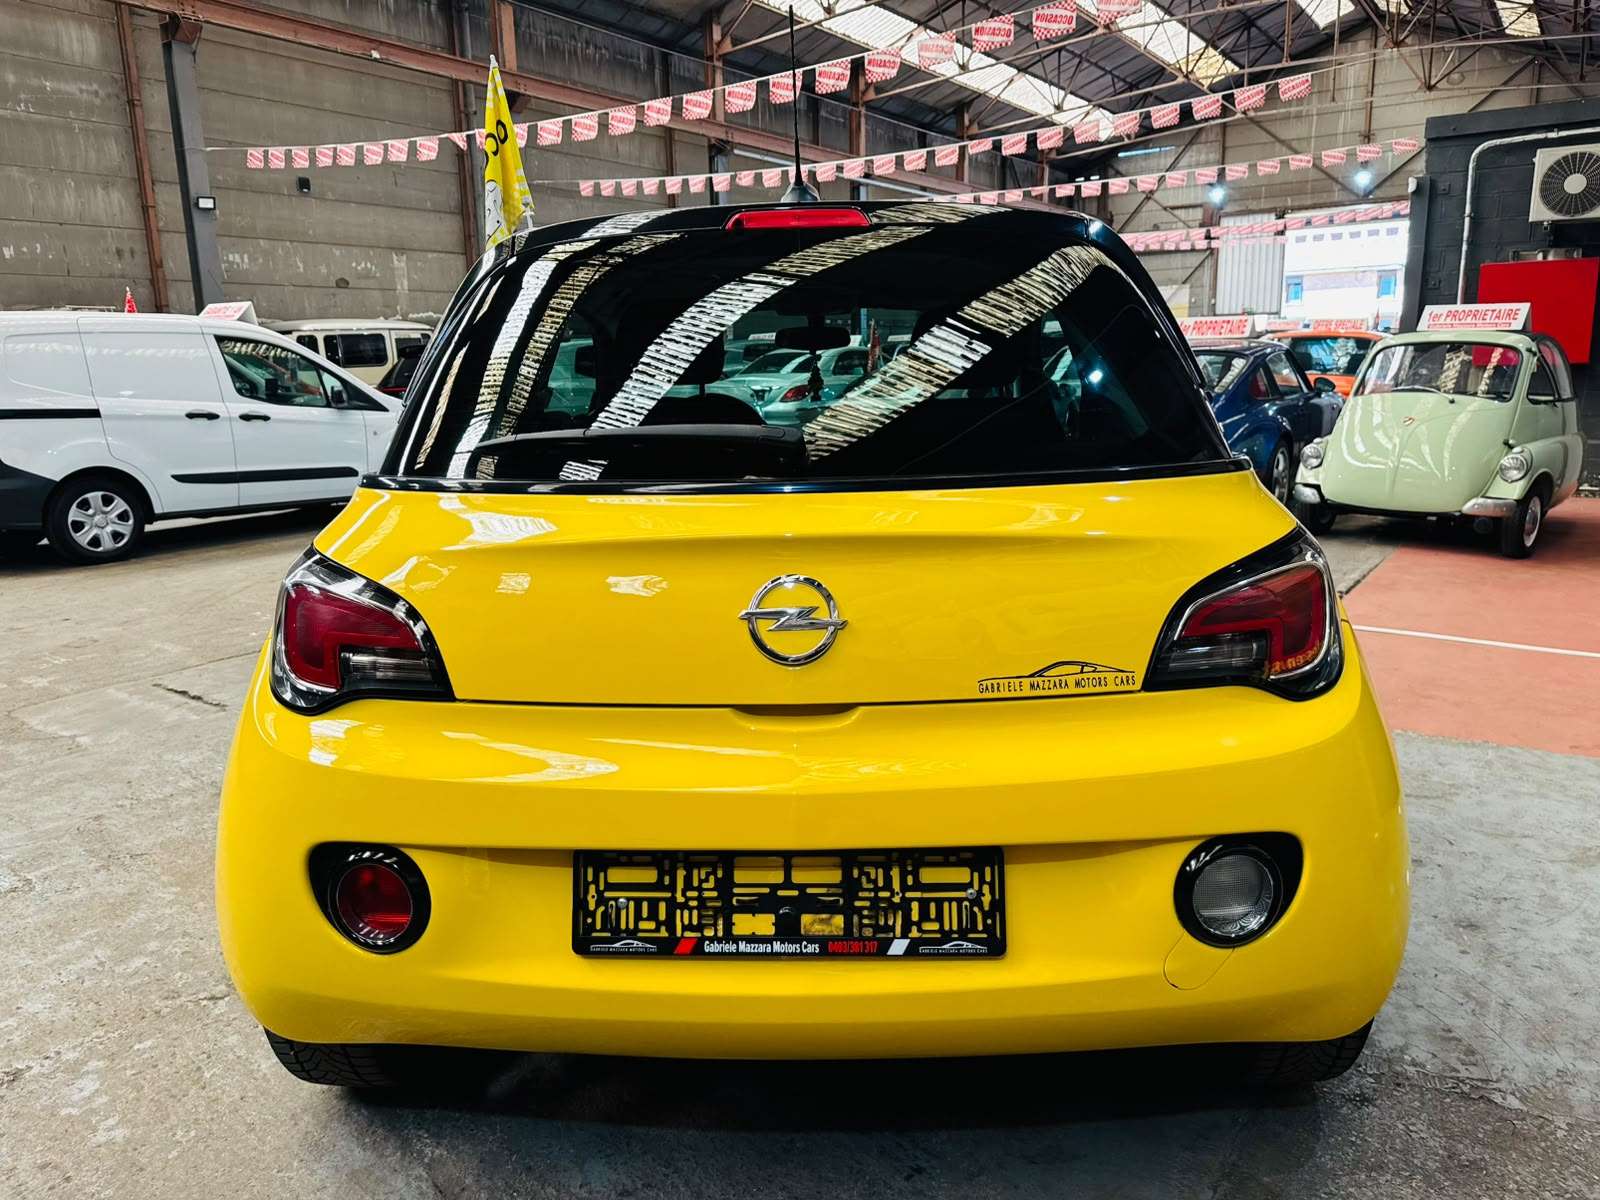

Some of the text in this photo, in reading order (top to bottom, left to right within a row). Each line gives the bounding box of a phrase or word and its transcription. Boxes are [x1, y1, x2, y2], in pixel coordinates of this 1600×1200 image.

[1428, 308, 1521, 322] 1er PROPRIETAIRE
[1192, 319, 1248, 336] PROPRIETAIRE
[978, 675, 1136, 694] GABRIELE MAZZARA MOTORS CARS
[704, 941, 737, 953] Gabriele
[738, 942, 771, 953] Mazzara
[772, 941, 800, 953] Motors
[801, 941, 819, 953] Cars
